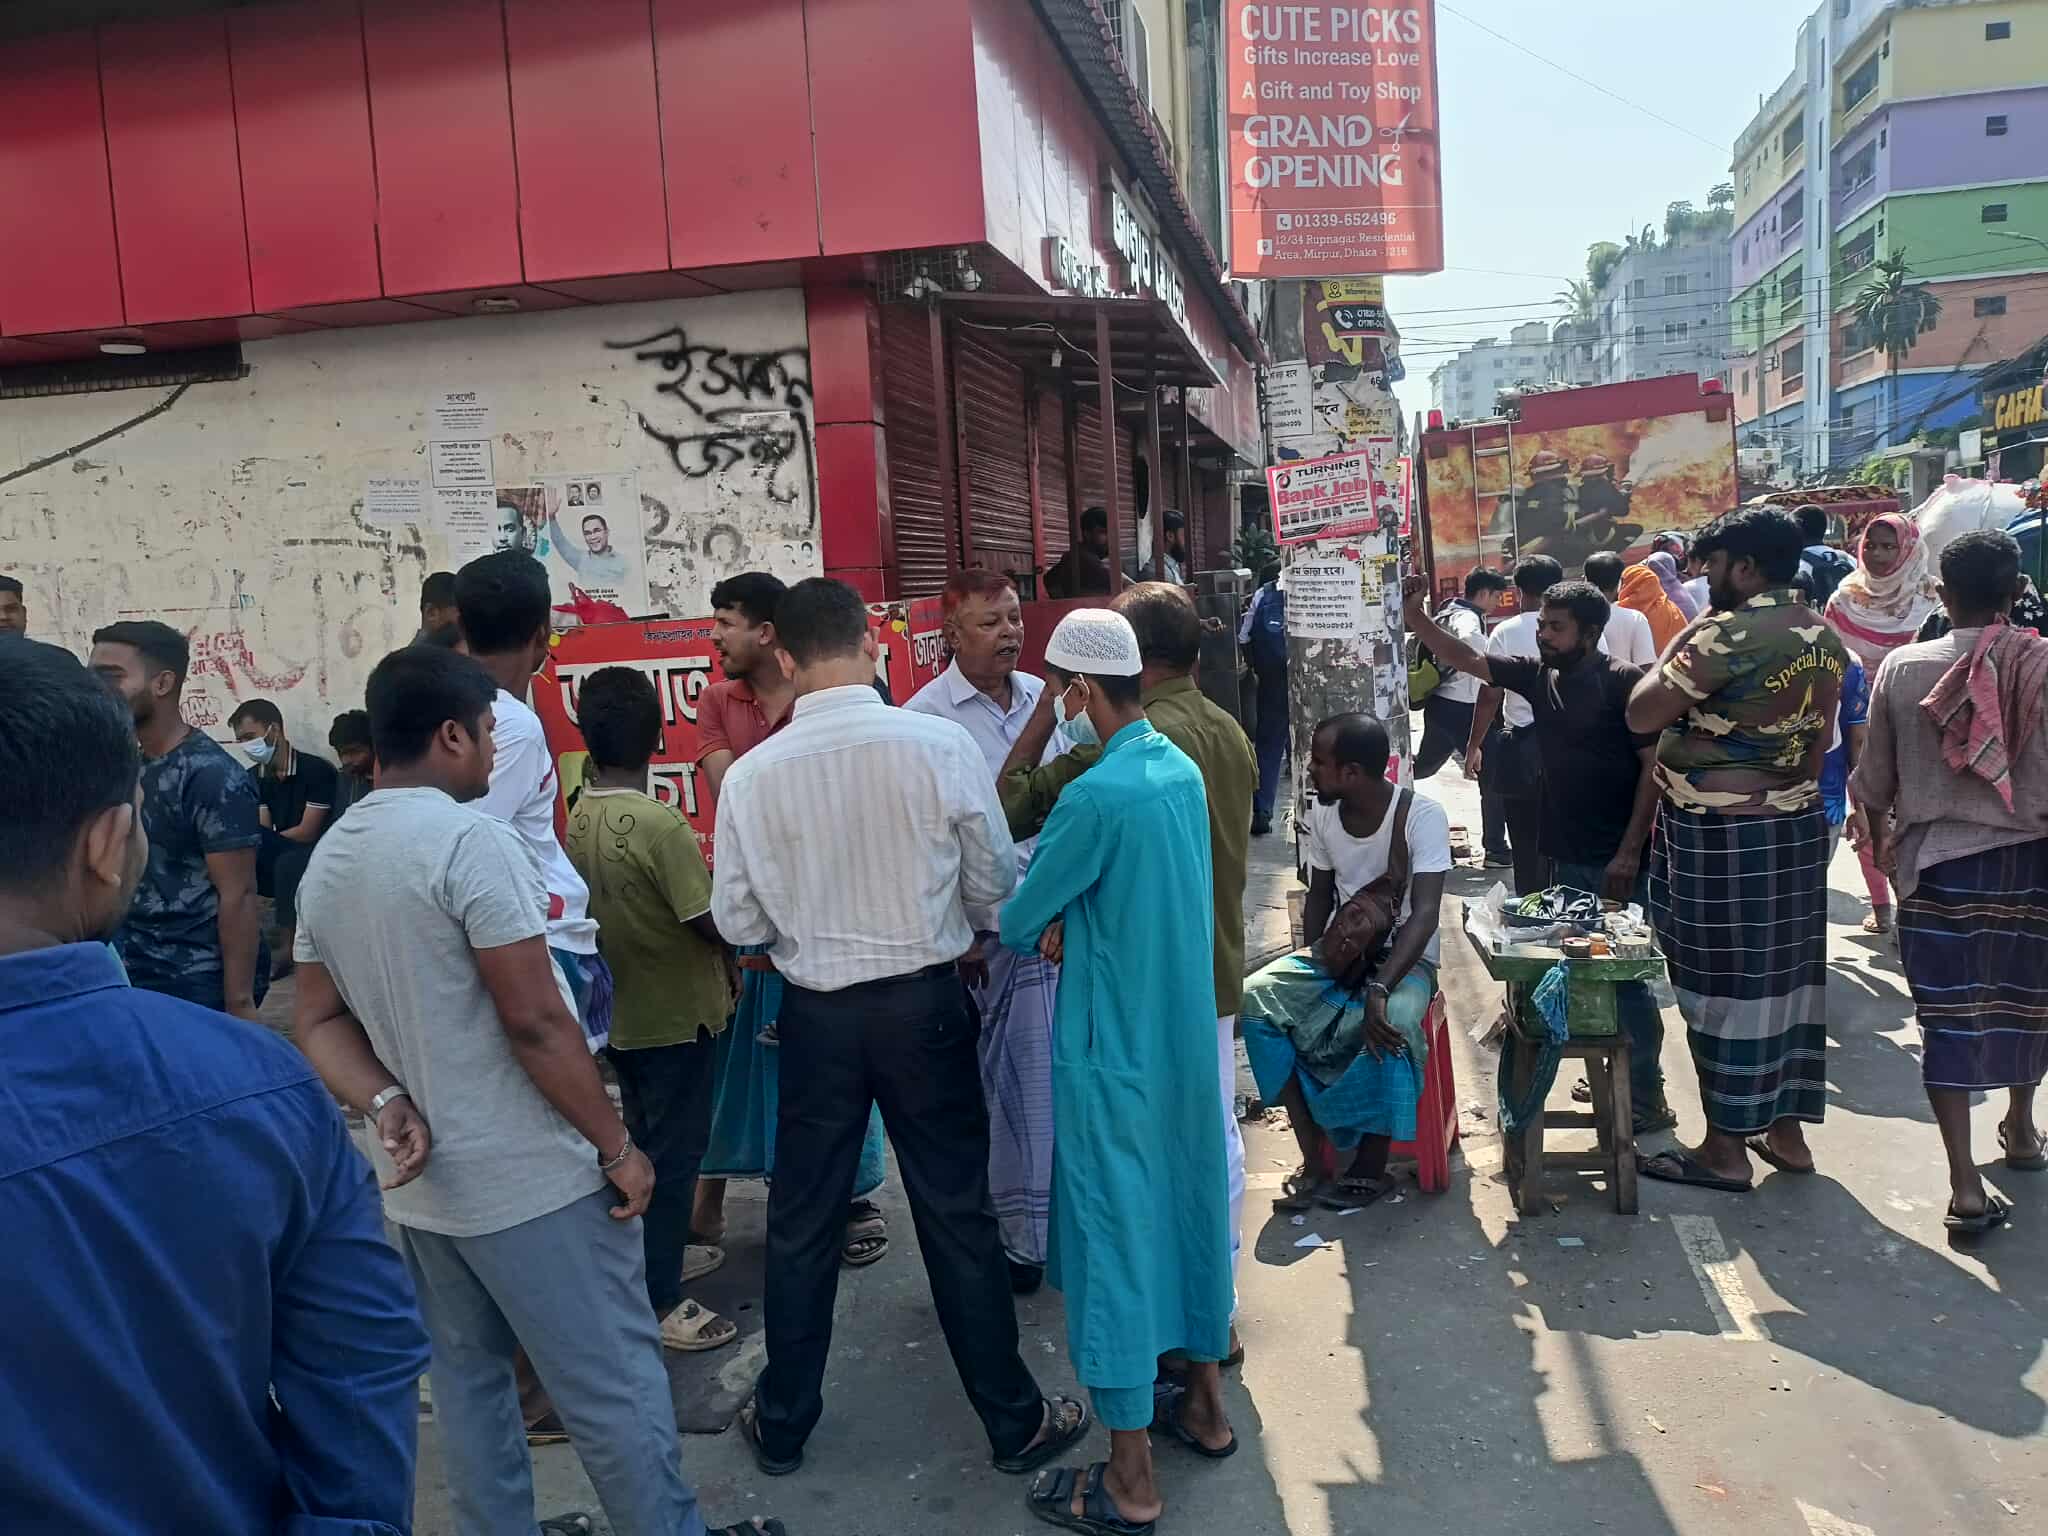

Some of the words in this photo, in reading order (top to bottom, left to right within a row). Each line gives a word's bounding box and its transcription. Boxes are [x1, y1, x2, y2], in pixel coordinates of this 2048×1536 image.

[1241, 5, 1321, 42] CUTE
[1331, 7, 1421, 44] PICKS
[1244, 46, 1288, 65] Gifts
[1295, 47, 1371, 66] Increase
[1377, 48, 1420, 66] Love
[1242, 82, 1256, 99] A
[1261, 81, 1293, 99] Gift
[1300, 81, 1333, 99] and
[1338, 82, 1371, 104] Toy
[1376, 82, 1421, 104] Shop
[1243, 115, 1373, 148] GRAND
[1244, 154, 1404, 188] OPENING
[1307, 234, 1355, 247] Rupnagar
[1359, 232, 1415, 242] Residential
[1344, 247, 1377, 257] Dhaka
[1295, 460, 1360, 478] TURNING
[1277, 484, 1327, 506] Bank
[1332, 479, 1368, 496] Job
[1764, 646, 1817, 693] Special
